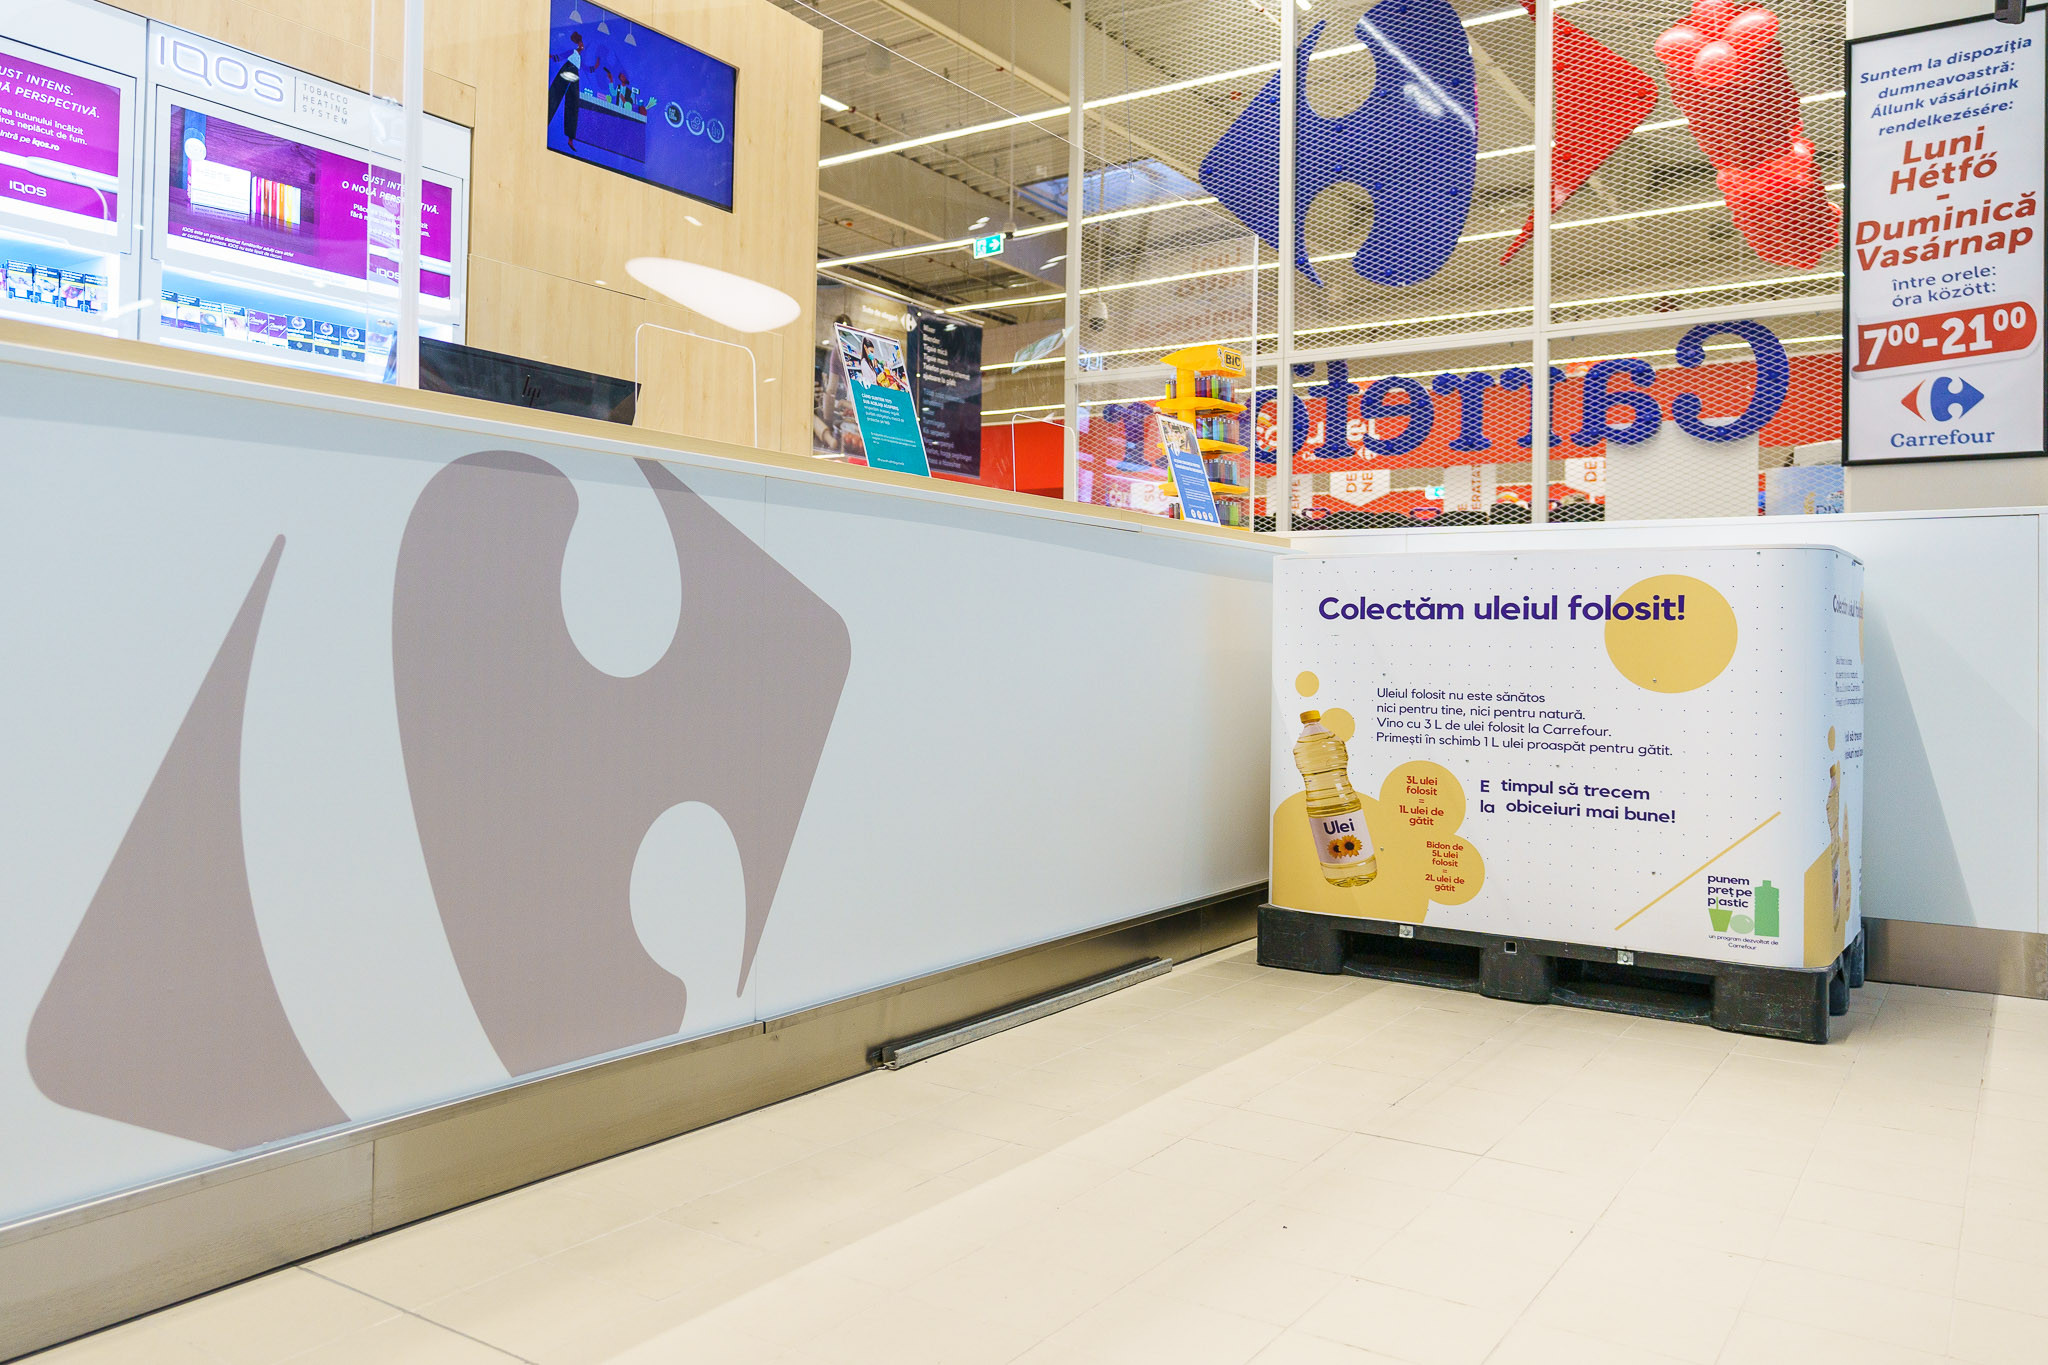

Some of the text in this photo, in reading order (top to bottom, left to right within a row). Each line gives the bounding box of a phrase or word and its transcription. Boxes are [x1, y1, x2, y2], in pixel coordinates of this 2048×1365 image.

[160, 35, 284, 103] IQOS
[1859, 63, 1922, 84] Suntem
[1927, 58, 1942, 70] la
[26, 74, 74, 96] INTENS.
[1878, 61, 2015, 99] dumneavoastră:
[15, 86, 100, 118] PERSPECTIVĂ.
[303, 83, 348, 105] TOBACCO
[1870, 78, 2019, 119] Állunk vásárlóink
[302, 104, 348, 125] SYSTEM
[303, 94, 348, 116] HEATING
[15, 110, 52, 127] tutunului
[1878, 100, 2014, 136] rendelkezésére:
[18, 120, 54, 137] neplăcut
[56, 130, 67, 140] de
[69, 134, 88, 146] fum.
[20, 136, 30, 144] pe
[1903, 125, 1985, 165] Luni
[362, 174, 386, 186] GUST
[1889, 151, 1998, 195] Hétfő
[10, 180, 47, 198] IQOS
[342, 180, 350, 189] O
[1855, 190, 2036, 246] Duminică
[1856, 226, 2033, 272] Vasárnap
[1892, 265, 1997, 292] între orele:
[1892, 281, 1996, 308] óra között:
[1890, 429, 1995, 448] Carrefour
[1318, 593, 1685, 621] Colectăm uleiul folosit!
[1376, 688, 1545, 703] Uleiul folosit nu este sănătos
[1376, 703, 1586, 720] nici pentru tine, nici pentru natură.
[1376, 718, 1612, 737] Vino cu 3 L de ulei folosit la Carrefour.
[1376, 732, 1673, 758] Primești în schimb 1 L ulei proaspăt pentru gătit.
[1406, 776, 1438, 786] 3L ulei
[1406, 785, 1438, 796] folosit
[1480, 779, 1650, 800] E timpul să trecem
[1399, 804, 1444, 817] 1L ulei de
[1480, 800, 1676, 824] la obiceiuri mai bune!
[1322, 818, 1355, 835] Ulei
[1409, 815, 1434, 827] gătit
[1426, 840, 1464, 851] Bidon de
[1432, 850, 1459, 860] 5L ulei
[1432, 858, 1458, 868] folosit
[1425, 874, 1465, 885] 2L ulei de
[1434, 883, 1455, 893] gătit
[1708, 875, 1750, 886] punem
[1708, 886, 1752, 898] preț pe
